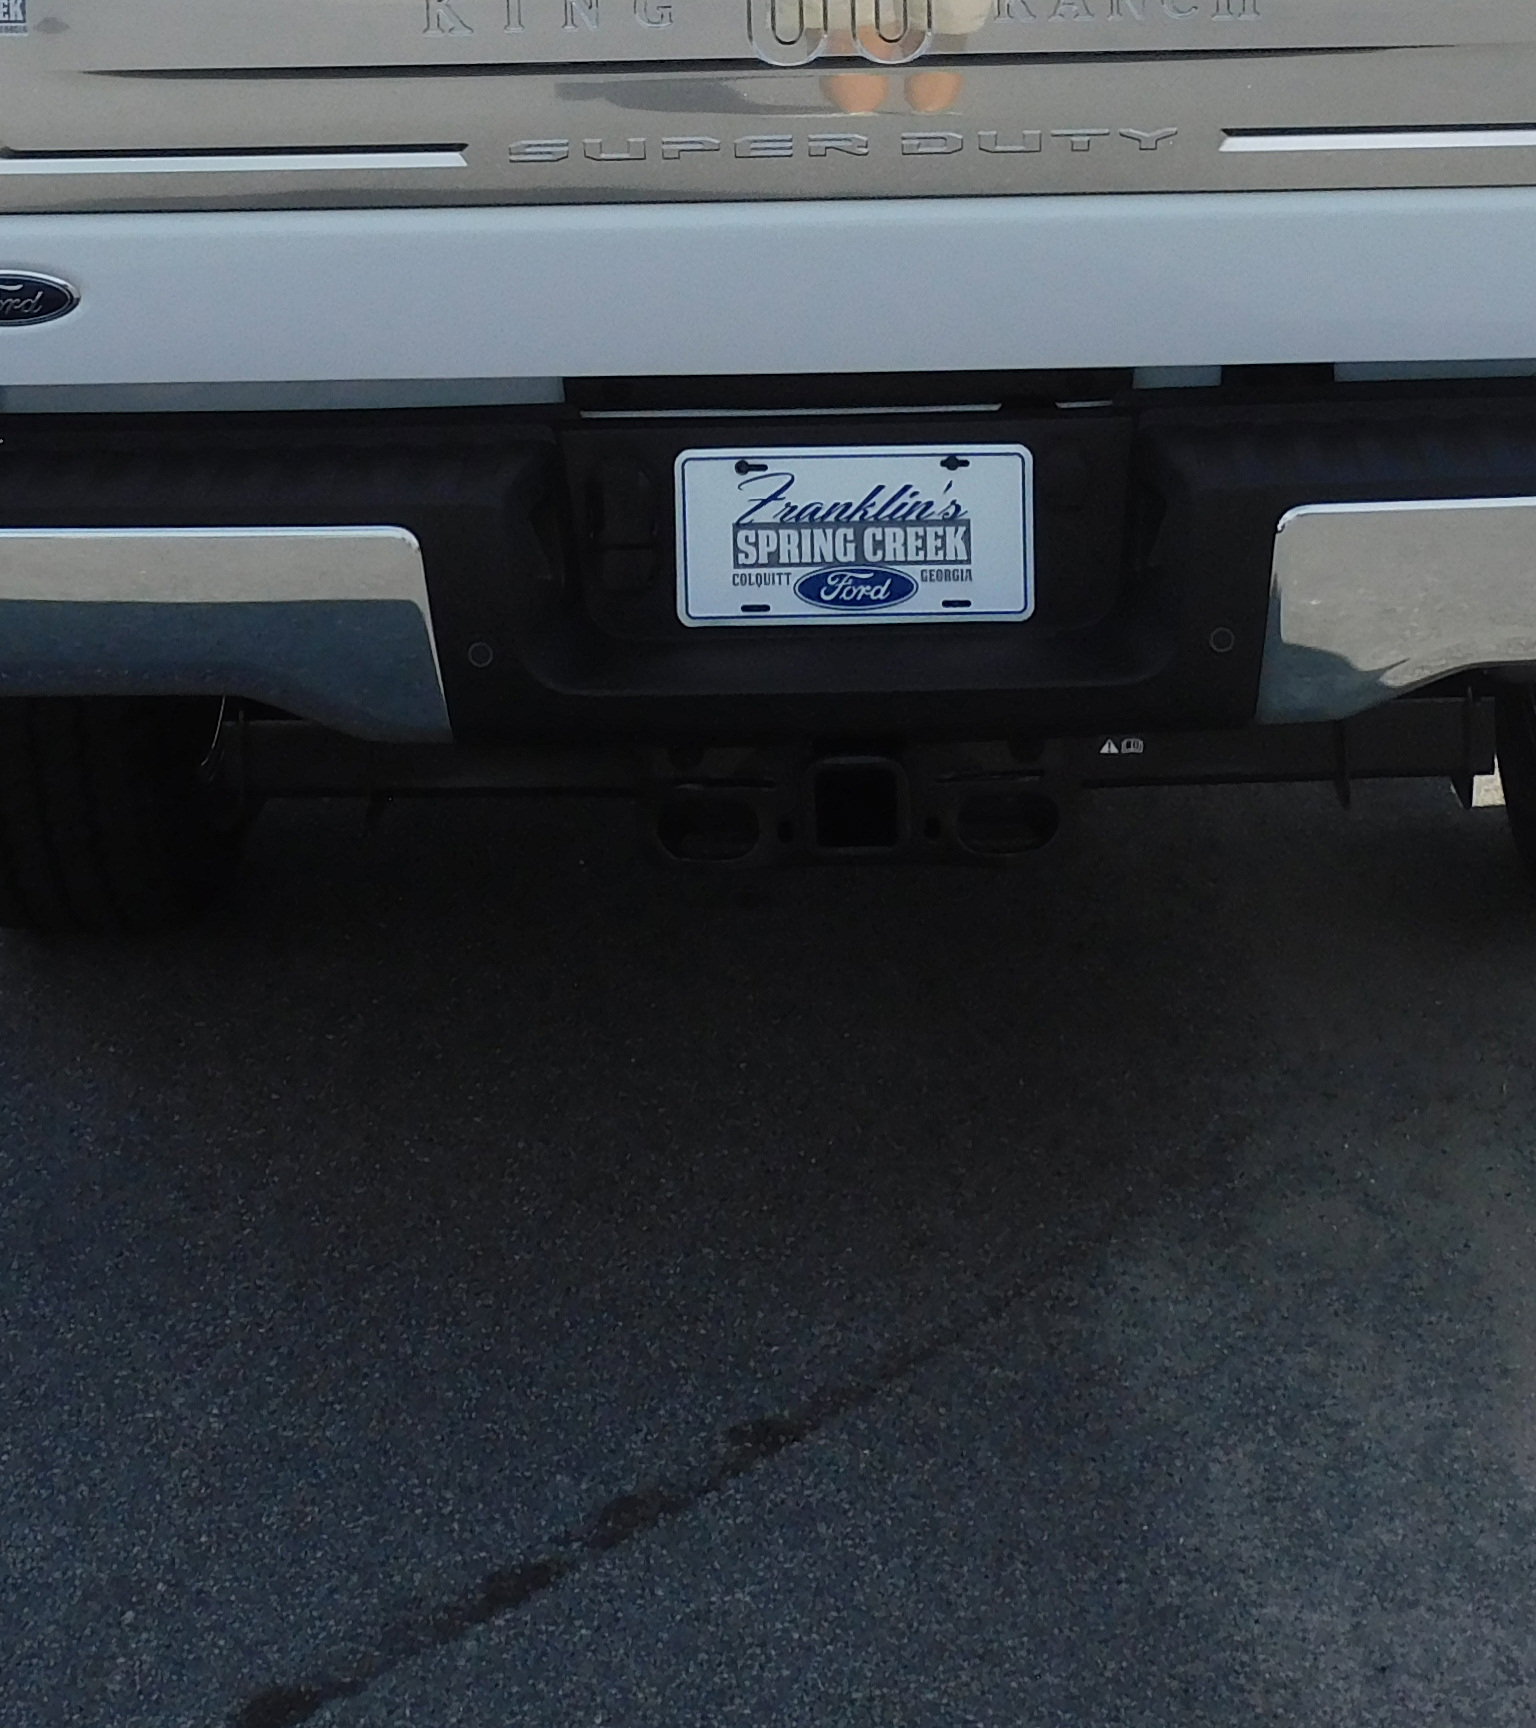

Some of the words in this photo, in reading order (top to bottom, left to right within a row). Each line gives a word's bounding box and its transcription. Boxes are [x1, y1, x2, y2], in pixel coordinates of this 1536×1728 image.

[508, 133, 869, 163] SUPER
[901, 127, 1178, 155] DUTY
[736, 472, 969, 525] Franklin's
[736, 527, 856, 565] SPRING
[863, 525, 969, 562] CREEK
[732, 572, 792, 588] COLQUITT
[820, 572, 891, 601] Ford
[920, 568, 973, 583] GEORGIA
